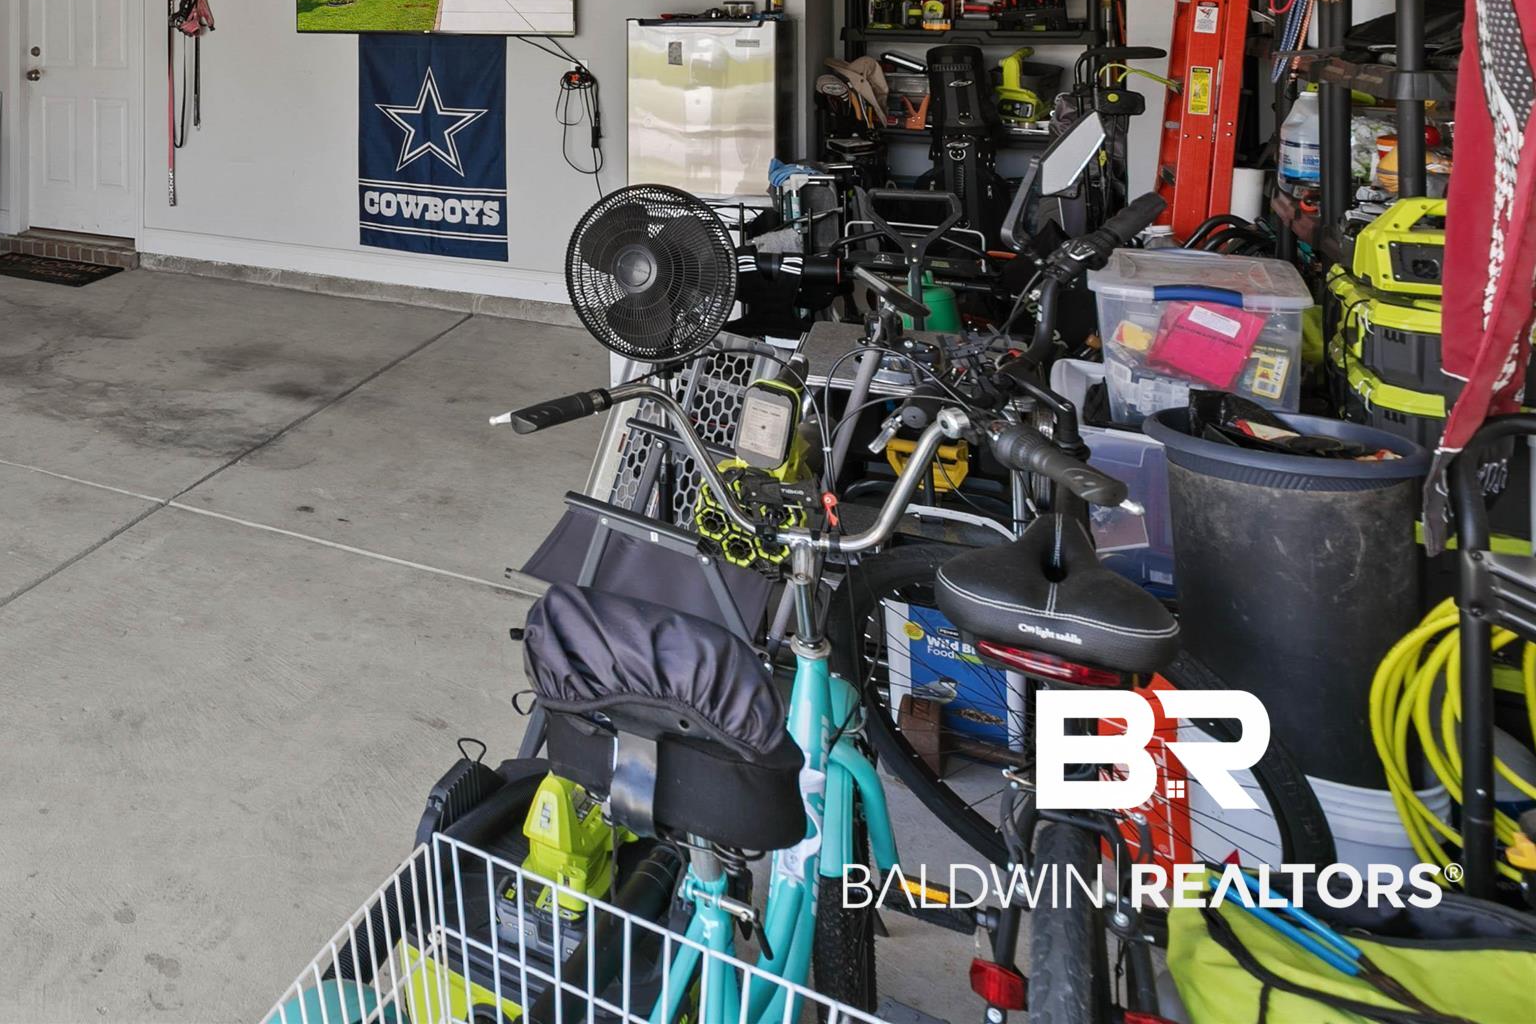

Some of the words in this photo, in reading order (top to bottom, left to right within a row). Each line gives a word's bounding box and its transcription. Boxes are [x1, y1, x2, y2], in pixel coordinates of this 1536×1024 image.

[364, 190, 500, 226] COWBOYS
[926, 635, 959, 651] Wild
[961, 643, 976, 655] Bi
[927, 646, 955, 659] Food
